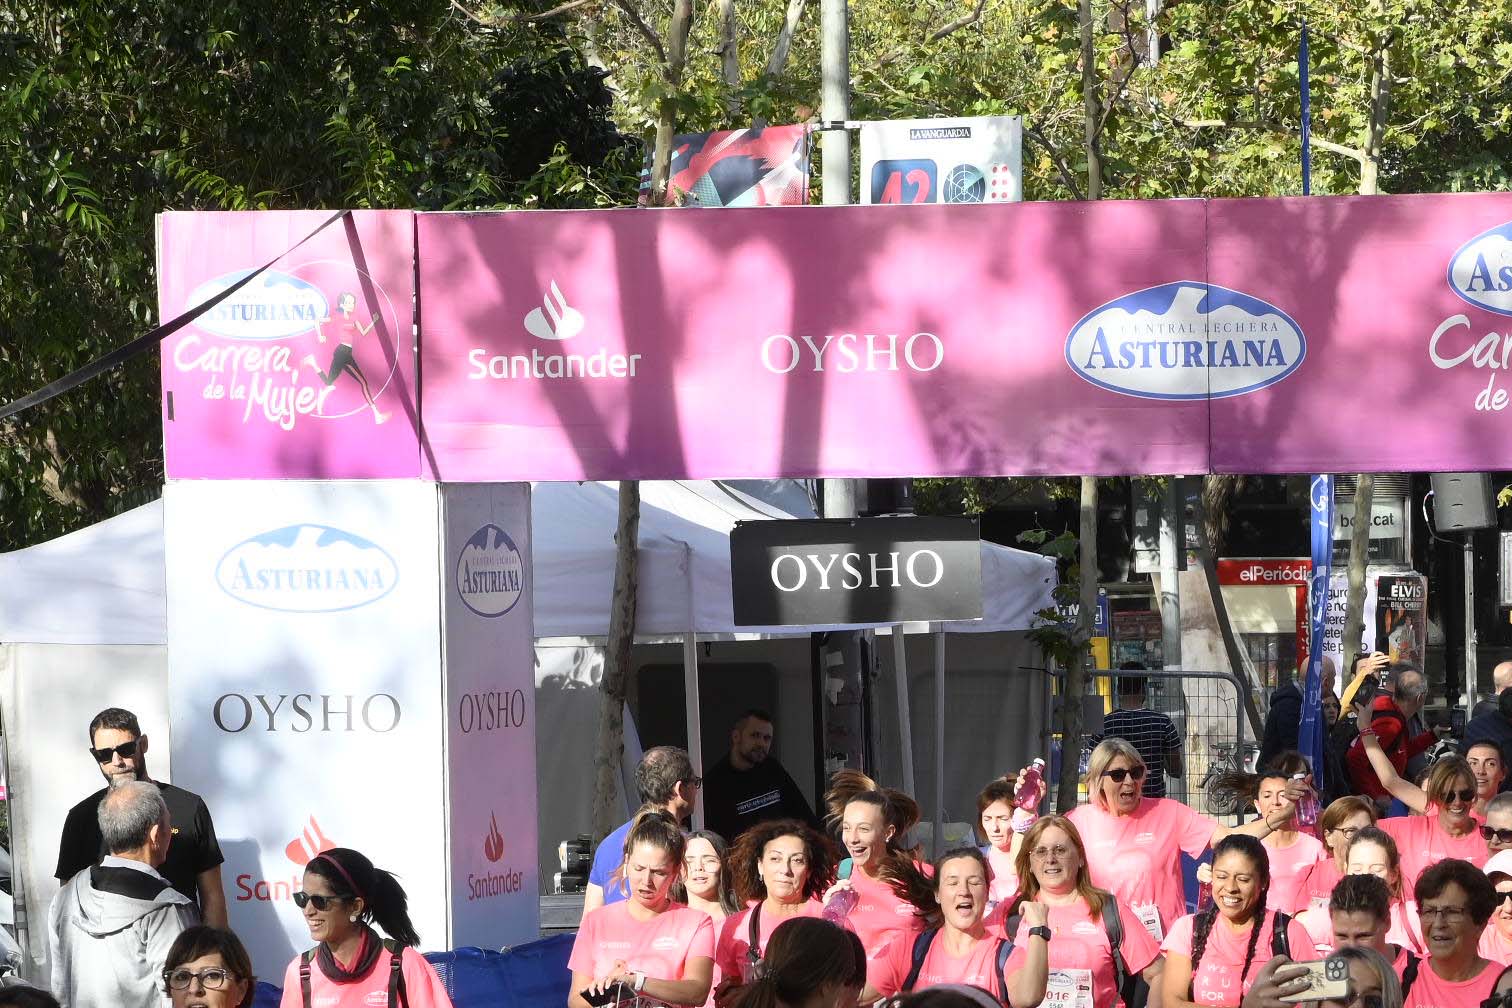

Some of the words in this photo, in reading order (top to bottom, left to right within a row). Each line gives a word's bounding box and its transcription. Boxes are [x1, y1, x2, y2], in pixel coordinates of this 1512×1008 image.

[1121, 322, 1195, 335] CENTRAL
[1204, 321, 1279, 334] LECHERA
[173, 334, 292, 373] Carrera
[468, 348, 642, 380] Santander
[761, 332, 945, 375] OYSHO
[1083, 326, 1288, 370] ASTURIANA
[202, 375, 224, 400] de
[229, 375, 246, 400] la
[243, 369, 336, 431] Mujer
[1475, 371, 1510, 413] de
[231, 558, 386, 592] ASTURIANA
[461, 559, 520, 597] ASTURIANA
[771, 549, 945, 592] OYSHO
[1390, 585, 1421, 598] ELVIS
[213, 693, 402, 734] OYSHO
[459, 689, 526, 734] OYSHO
[467, 867, 523, 901] Santander
[1201, 991, 1224, 1001] FOR
